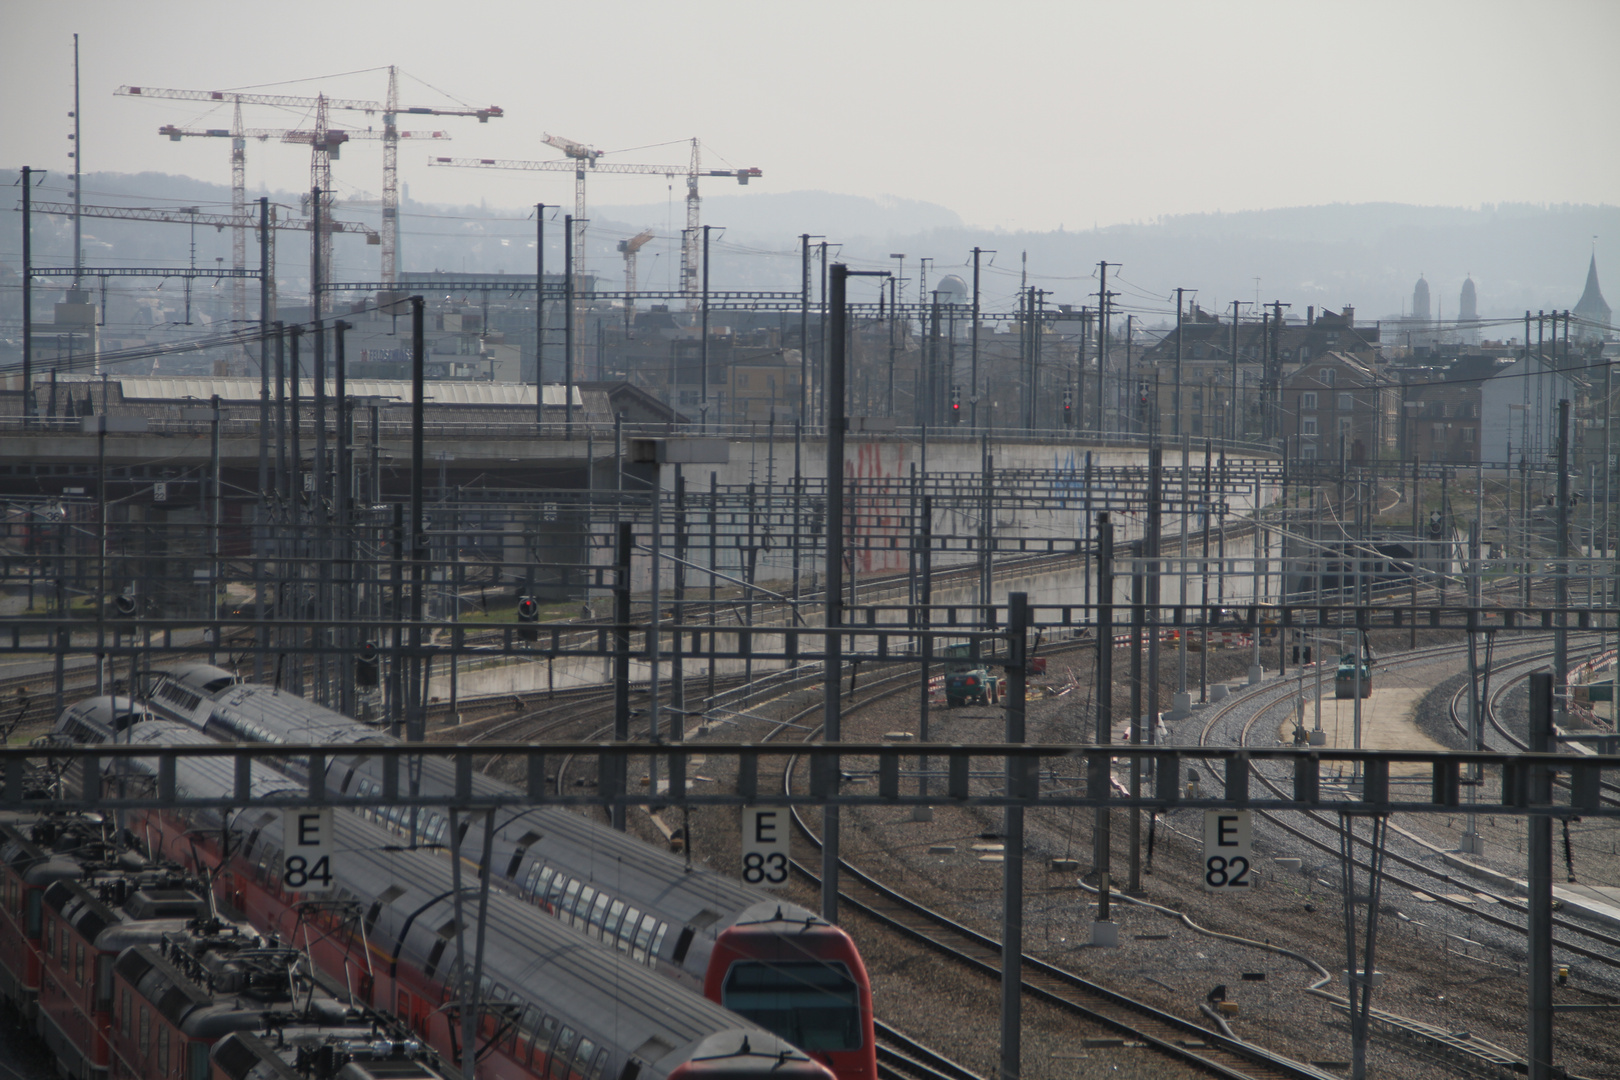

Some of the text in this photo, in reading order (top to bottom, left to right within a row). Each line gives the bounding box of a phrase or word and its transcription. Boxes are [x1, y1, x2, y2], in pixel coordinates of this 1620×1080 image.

[298, 814, 320, 846] E
[756, 812, 777, 843] E
[1218, 815, 1239, 847] E
[284, 854, 333, 888] 84
[742, 851, 788, 884] 83
[1206, 855, 1250, 888] 82
